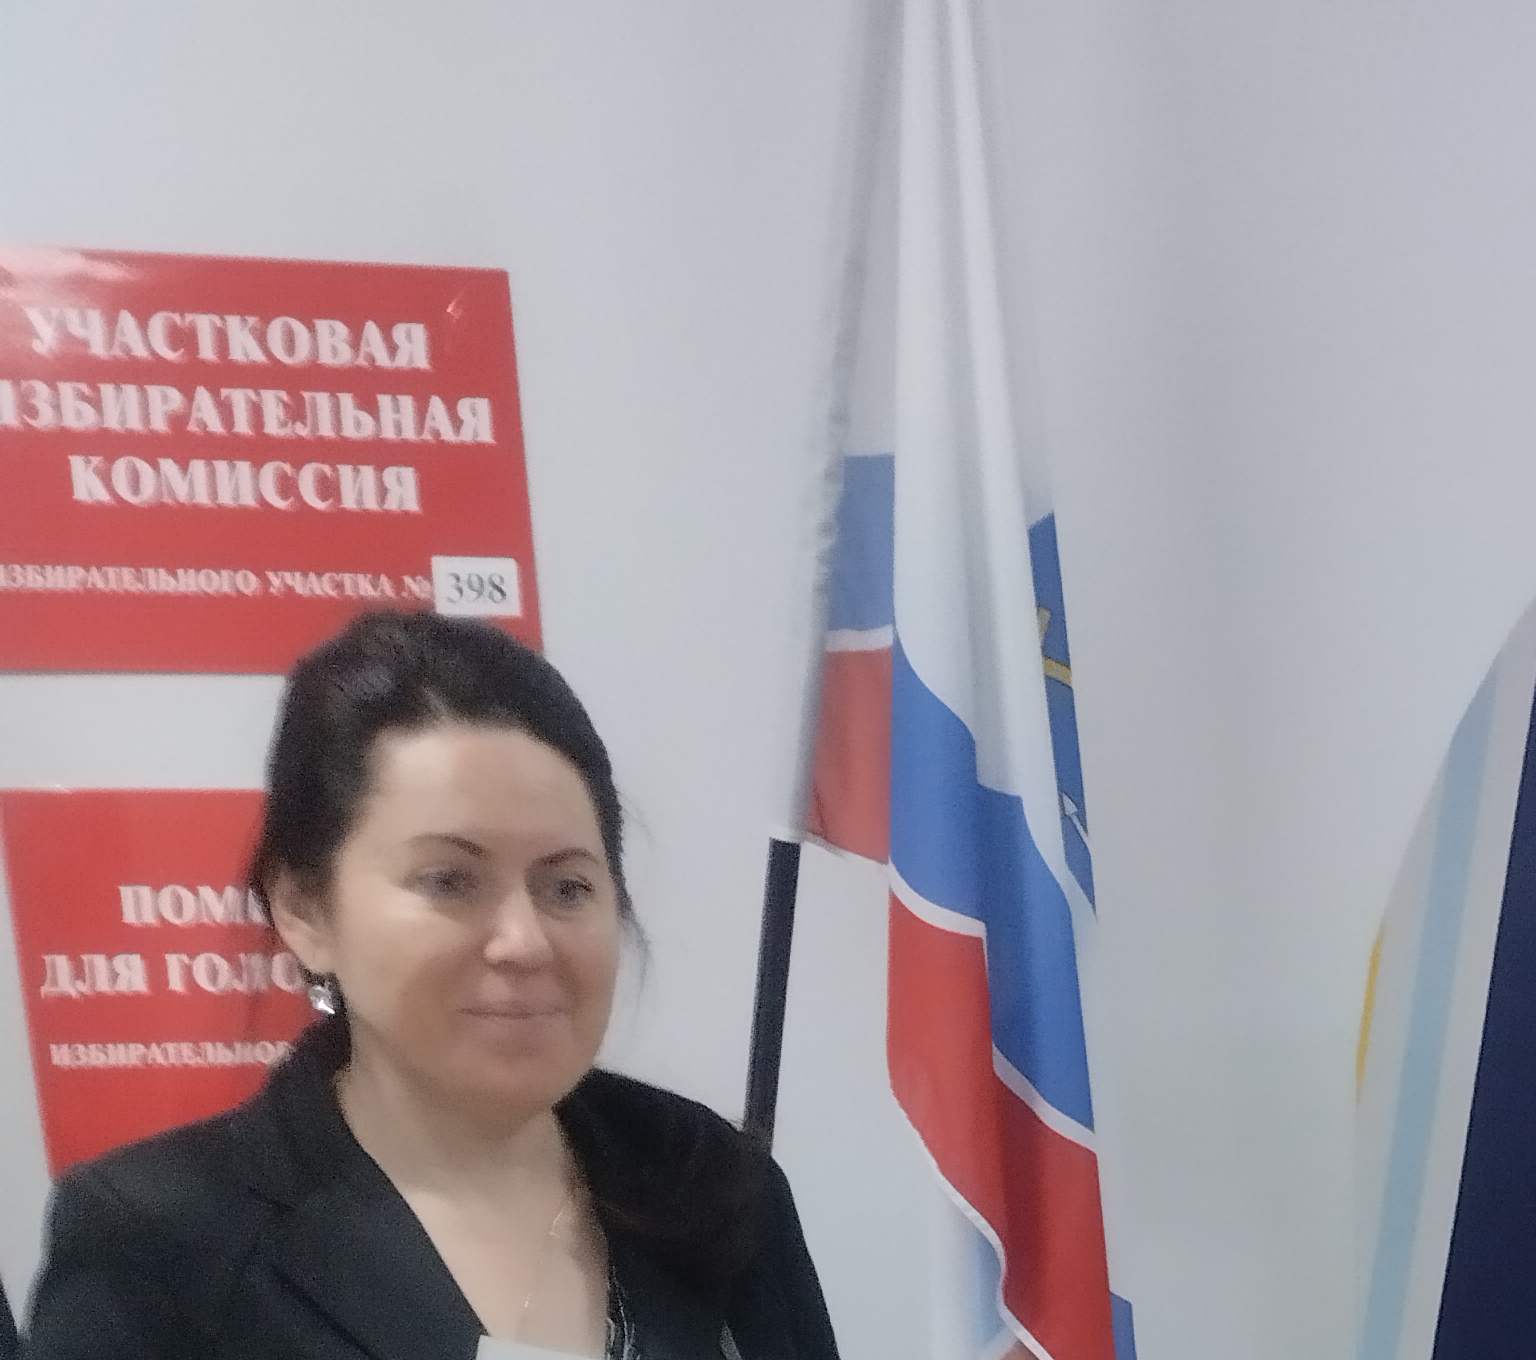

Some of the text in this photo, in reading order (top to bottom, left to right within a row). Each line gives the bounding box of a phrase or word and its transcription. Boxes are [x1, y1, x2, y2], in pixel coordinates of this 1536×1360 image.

[23, 305, 434, 370] УЧАСТКОВАЯ
[68, 455, 424, 513] КОМИССИЯ
[0, 564, 260, 596] ЗБИРАТЕЛЬНОГО
[265, 571, 395, 599] УЧАСТКА
[447, 571, 507, 604] 398
[41, 952, 151, 999] ДЛЯ
